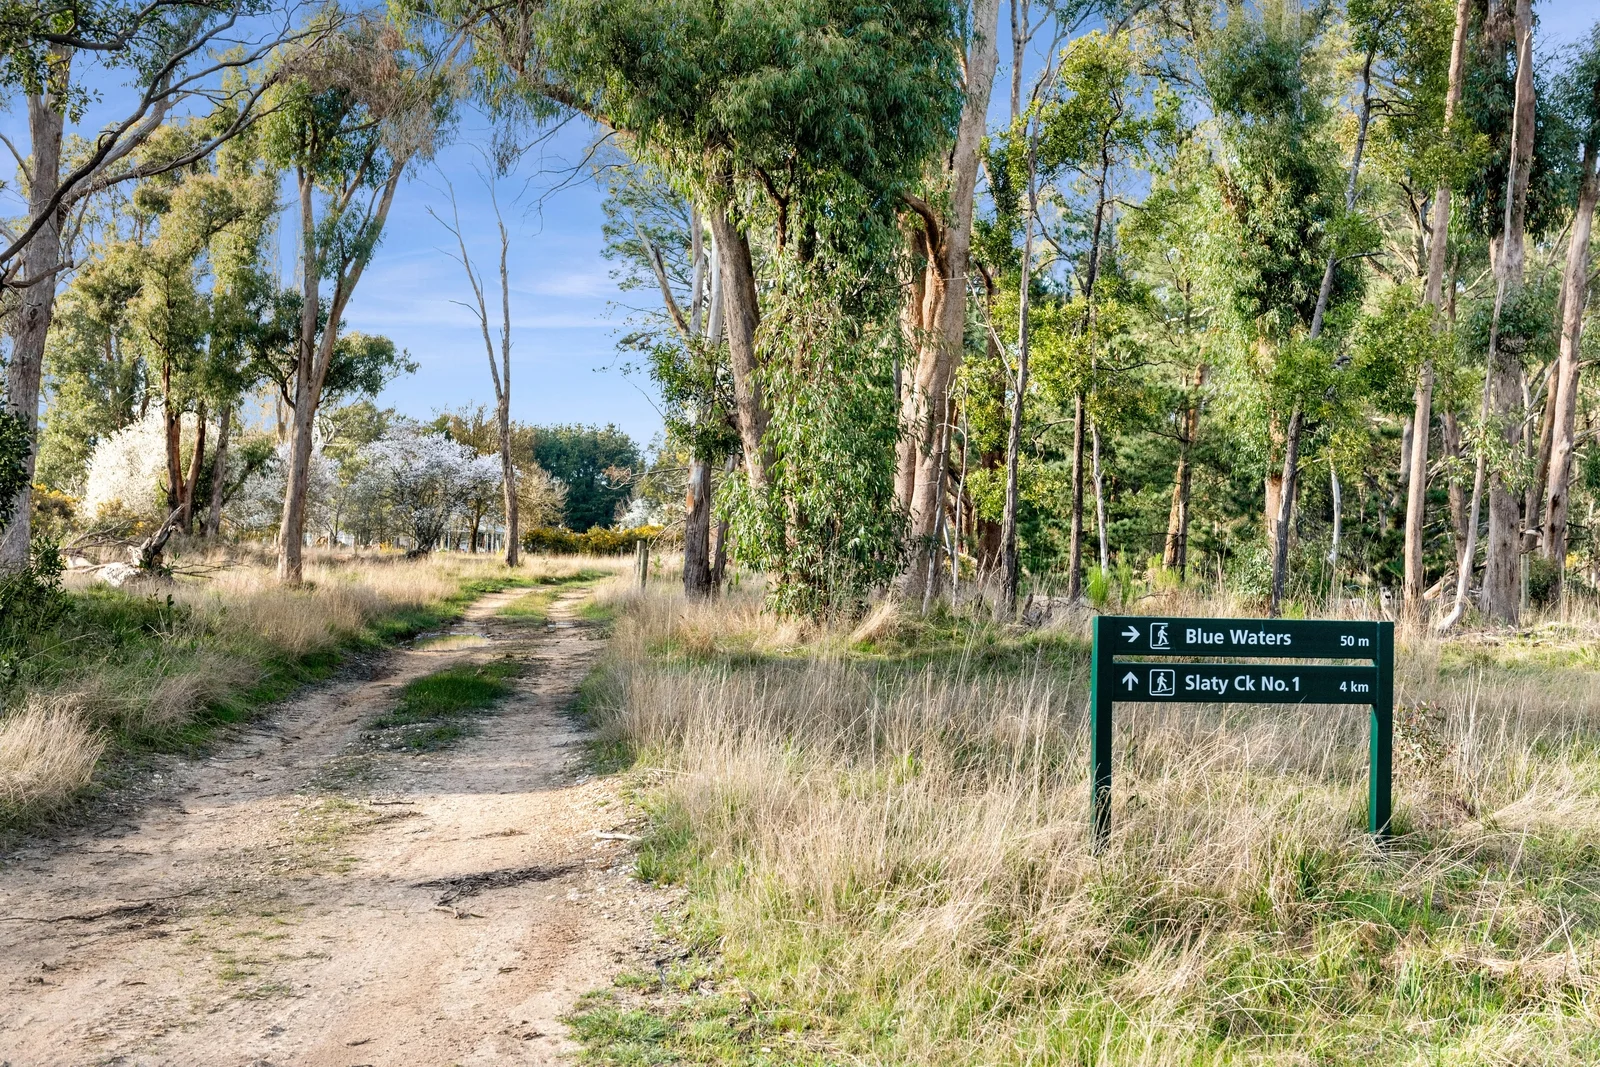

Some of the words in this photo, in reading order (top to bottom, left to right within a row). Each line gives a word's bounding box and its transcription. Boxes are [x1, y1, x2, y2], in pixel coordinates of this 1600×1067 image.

[1185, 628, 1225, 645] Blue
[1229, 629, 1292, 646] Waters
[1340, 635, 1355, 647] 50
[1358, 637, 1370, 647] m
[1185, 674, 1229, 695] Slaty
[1234, 675, 1256, 692] Ck
[1339, 681, 1348, 692] 4
[1350, 680, 1369, 693] km
